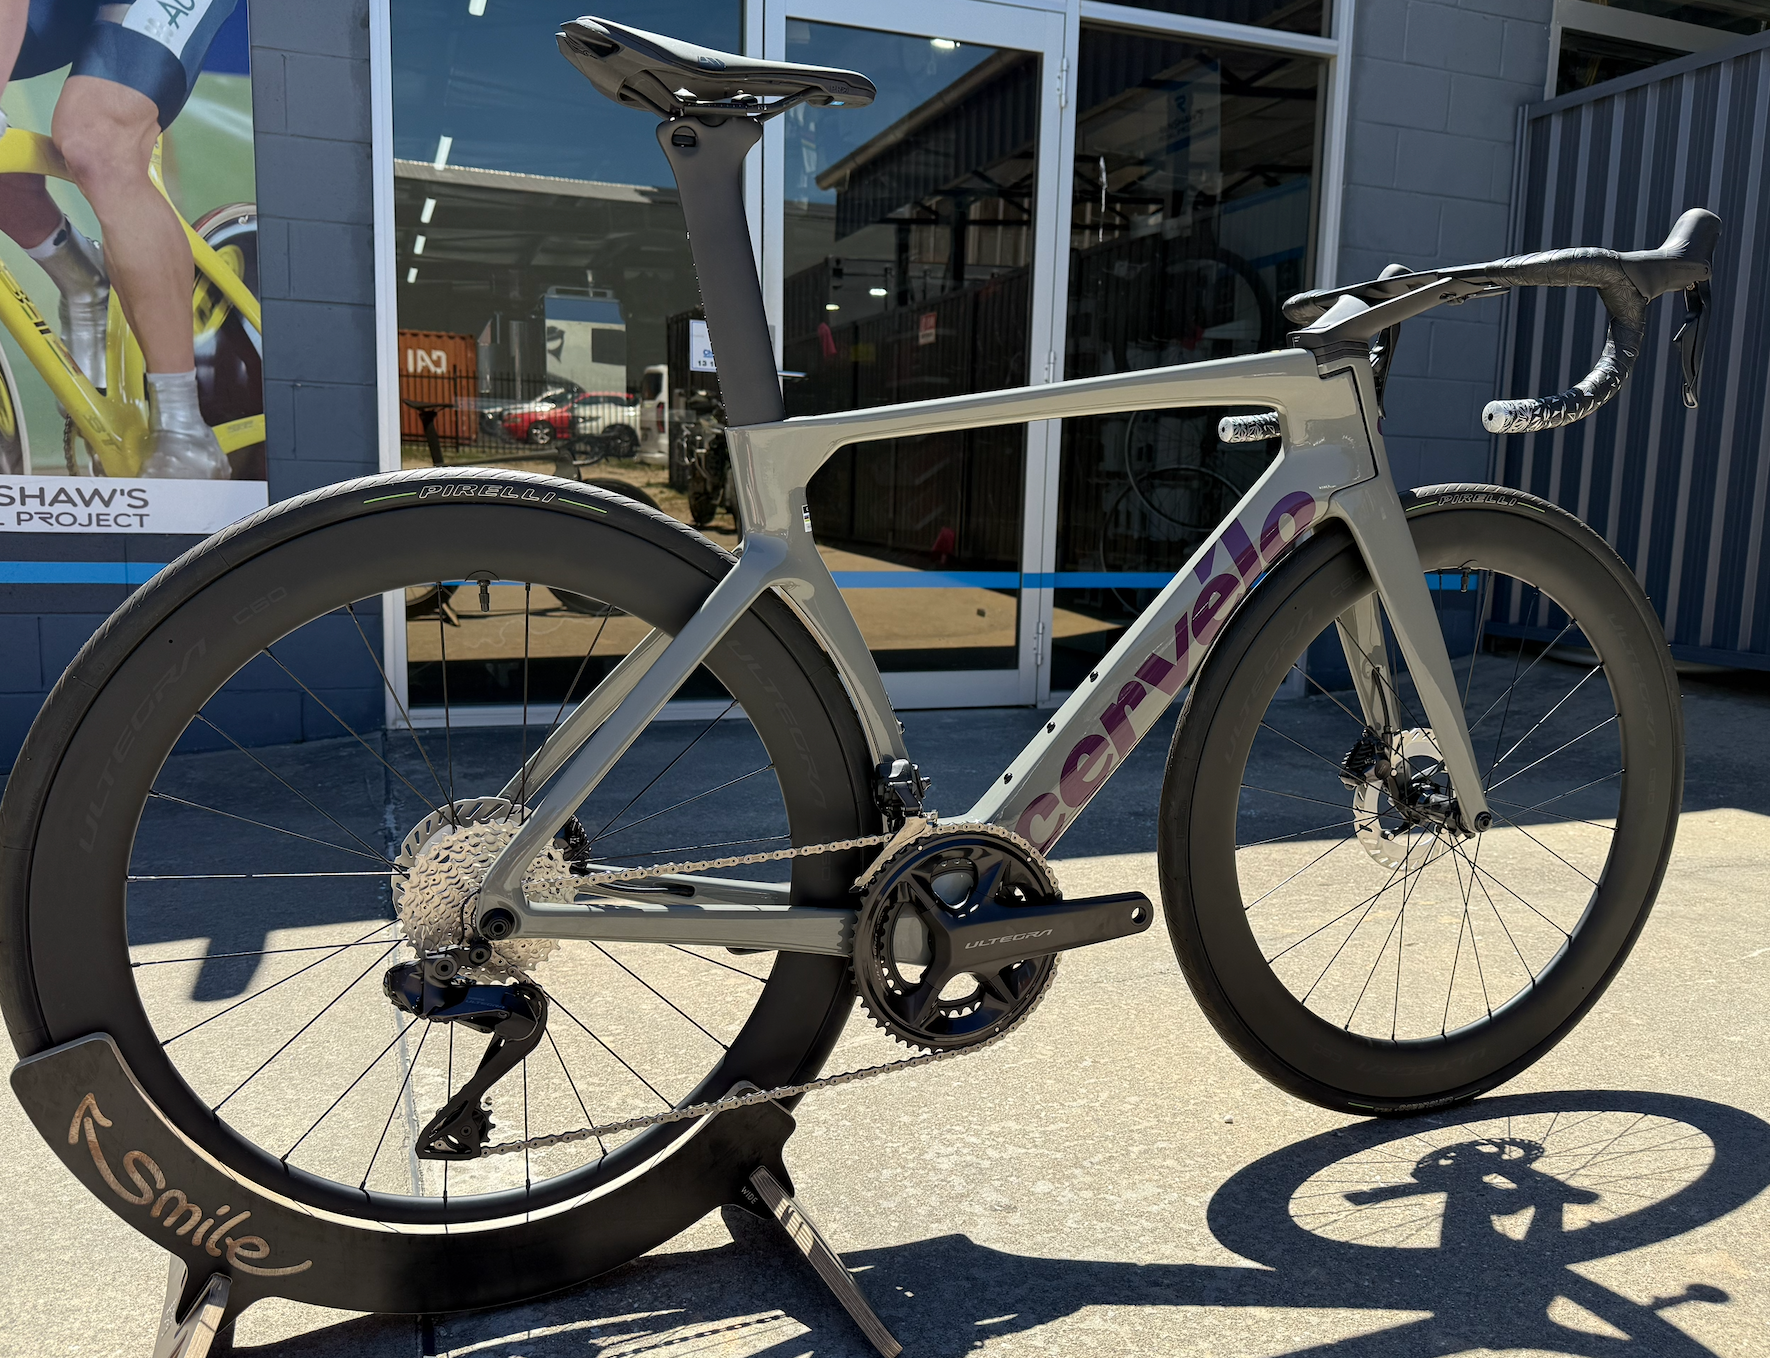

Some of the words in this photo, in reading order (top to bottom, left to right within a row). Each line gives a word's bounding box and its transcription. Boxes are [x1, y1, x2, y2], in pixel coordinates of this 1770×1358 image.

[418, 483, 558, 504] PIRELLI
[1437, 493, 1518, 507] PIRELLI
[16, 511, 150, 528] PROJECT
[1225, 606, 1314, 764] ULTEGRA
[726, 639, 827, 810] ULTEGRA
[79, 637, 207, 854] ULTEGRA
[965, 928, 1054, 950] ULTEGRA
[740, 1186, 760, 1205] WIDE
